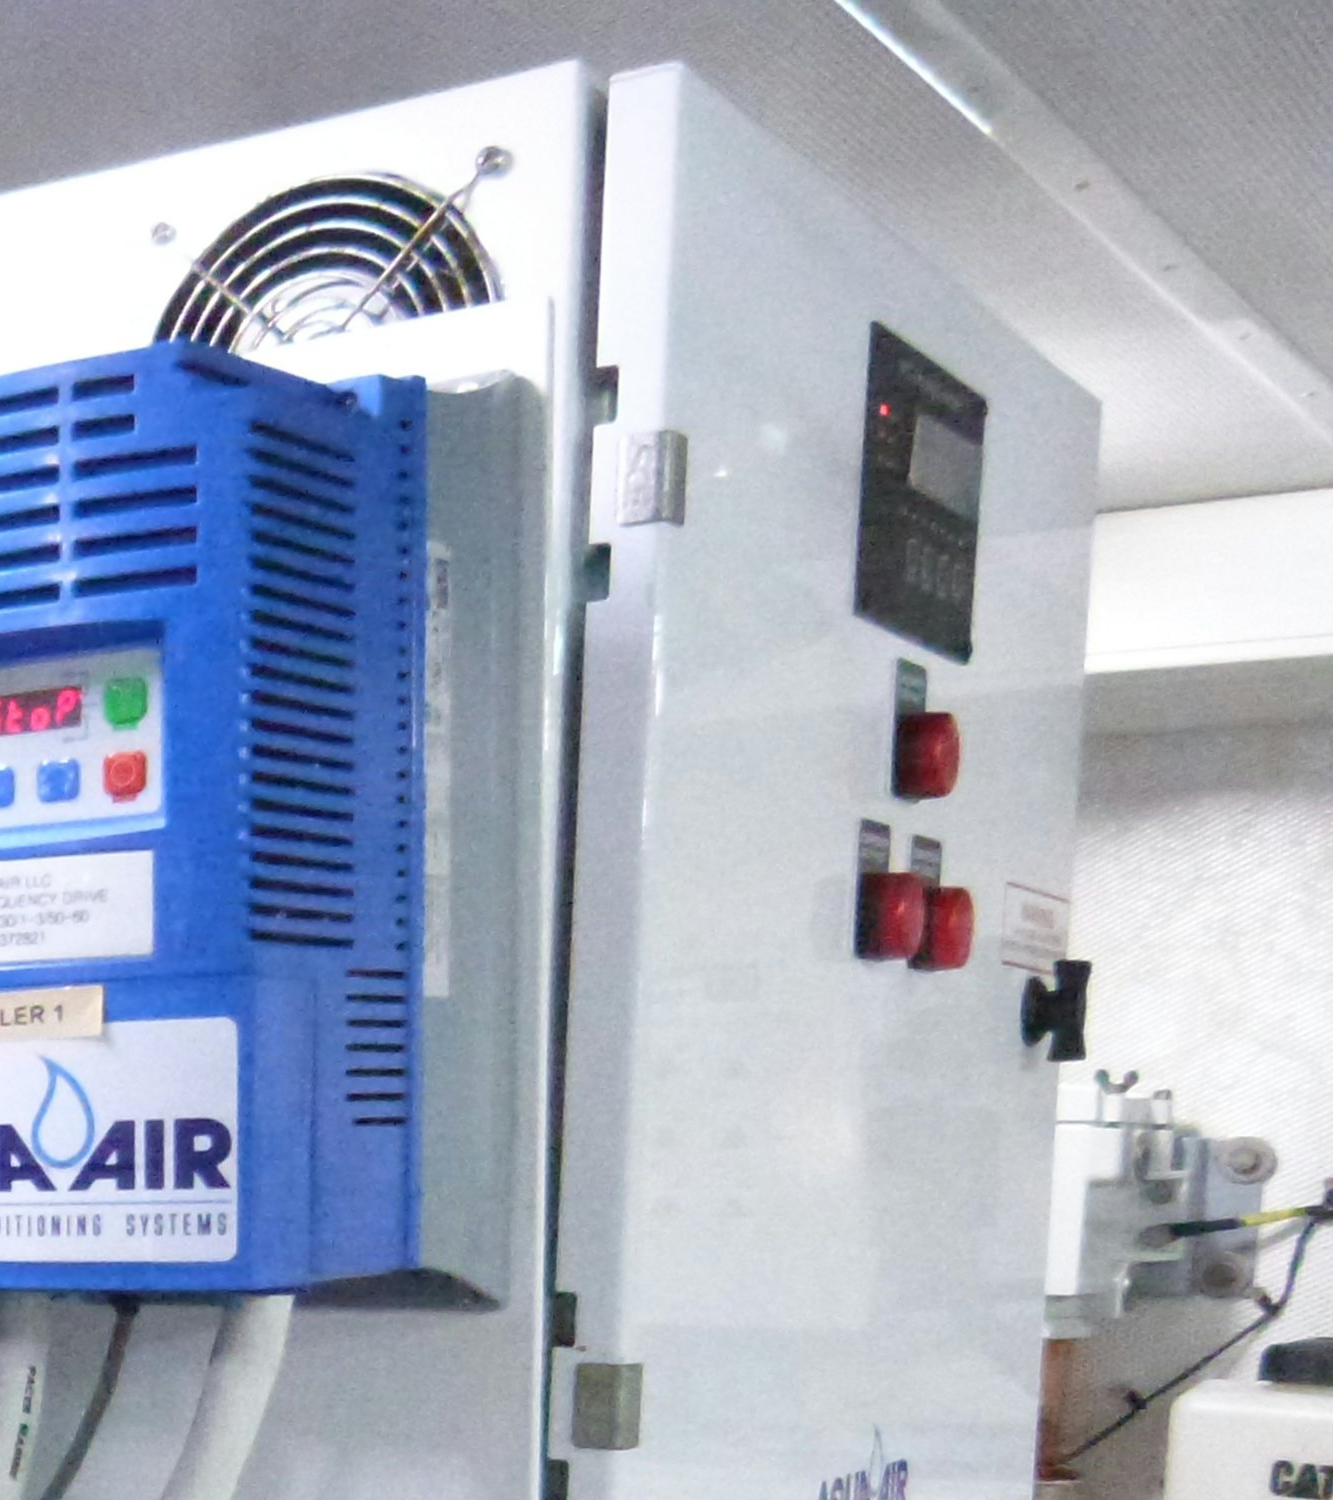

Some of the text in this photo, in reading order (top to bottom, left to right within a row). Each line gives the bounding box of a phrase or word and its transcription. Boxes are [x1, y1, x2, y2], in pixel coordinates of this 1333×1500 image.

[25, 873, 52, 888] LLC
[62, 888, 110, 904] DRIVE
[53, 1004, 64, 1022] 1
[68, 1117, 233, 1192] AIR
[125, 1212, 228, 1237] SYSTEMS
